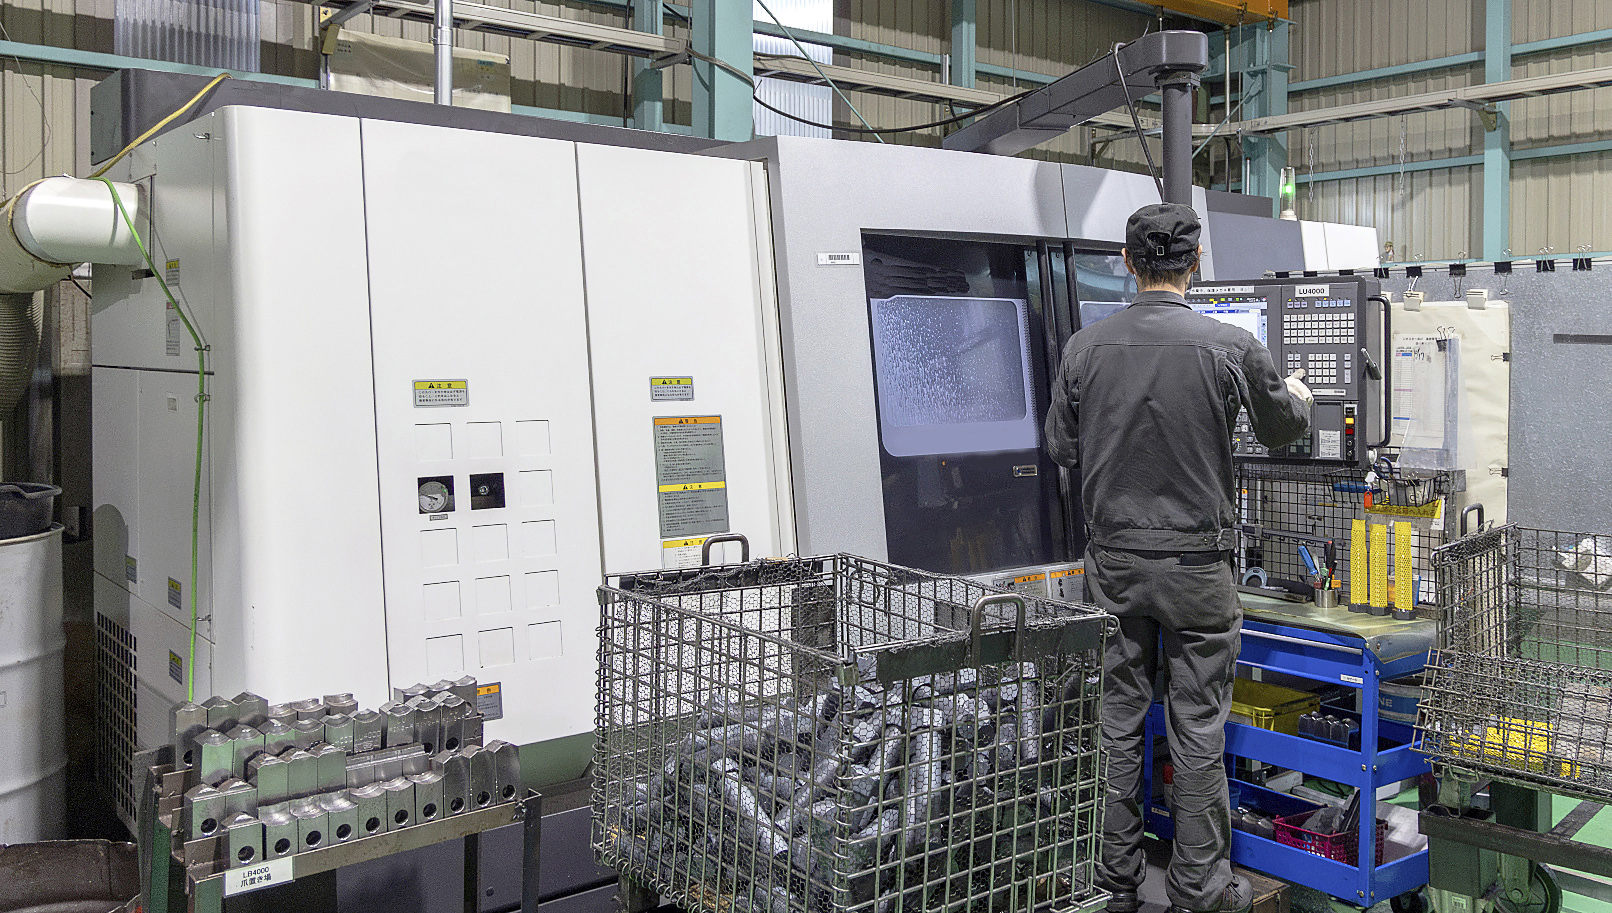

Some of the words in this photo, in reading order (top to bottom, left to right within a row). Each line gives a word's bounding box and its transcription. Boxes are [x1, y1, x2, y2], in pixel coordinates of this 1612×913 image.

[1299, 287, 1325, 295] LU4000
[242, 866, 270, 878] LB4000
[240, 872, 272, 888] 爪置き場
